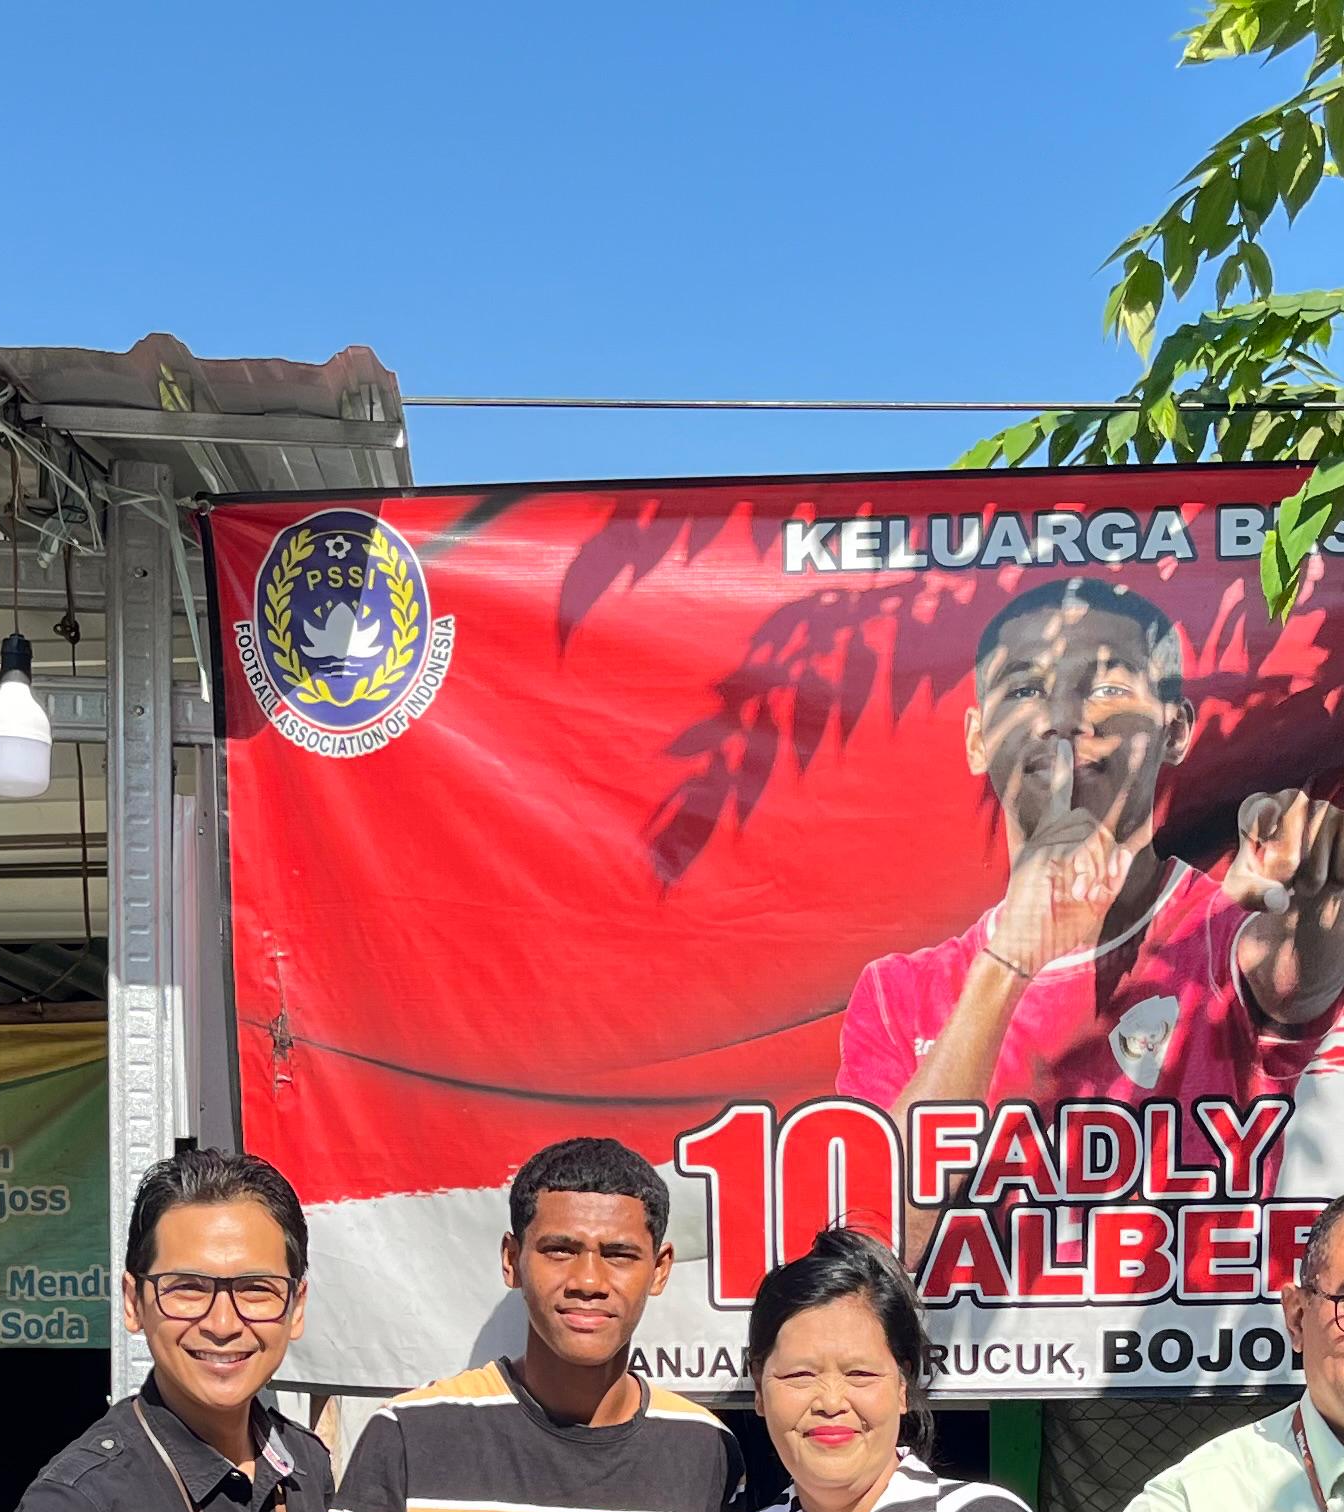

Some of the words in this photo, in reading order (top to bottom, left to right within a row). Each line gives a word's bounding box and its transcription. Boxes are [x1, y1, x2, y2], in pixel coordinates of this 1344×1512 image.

[783, 508, 1196, 573] KELUARGA
[306, 566, 375, 591] PSSI
[235, 622, 278, 717] FOOTBALL
[275, 710, 387, 755] ASSOCIATION
[385, 711, 409, 737] OF
[405, 616, 453, 717] INDONESIA
[908, 1098, 1294, 1204] FADLY
[676, 1098, 904, 1308] 10
[0, 1311, 86, 1340] Soda
[921, 1343, 1086, 1380] RUCUK,
